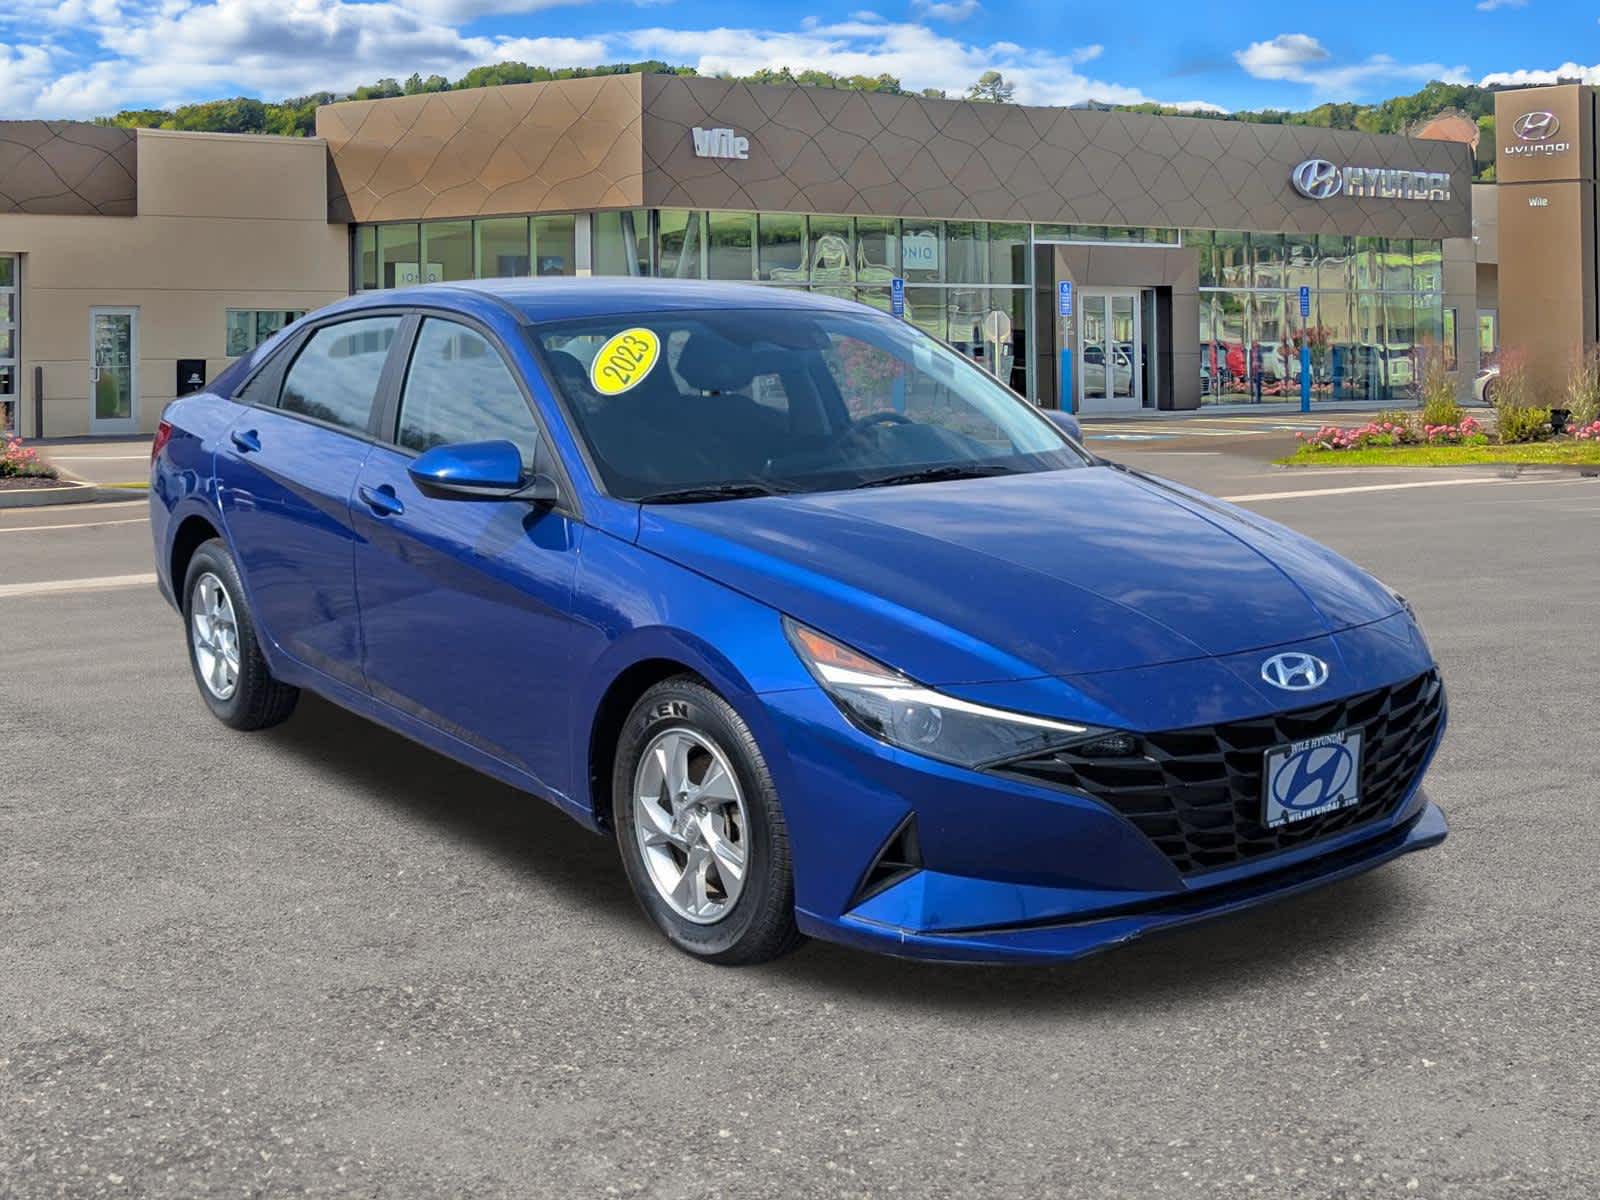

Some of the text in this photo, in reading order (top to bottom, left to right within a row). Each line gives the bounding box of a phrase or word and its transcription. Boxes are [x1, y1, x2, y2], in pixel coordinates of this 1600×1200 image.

[692, 127, 749, 159] Wile
[1343, 167, 1450, 201] HYUNDAI
[1528, 196, 1549, 207] Wile
[602, 335, 649, 385] 2023
